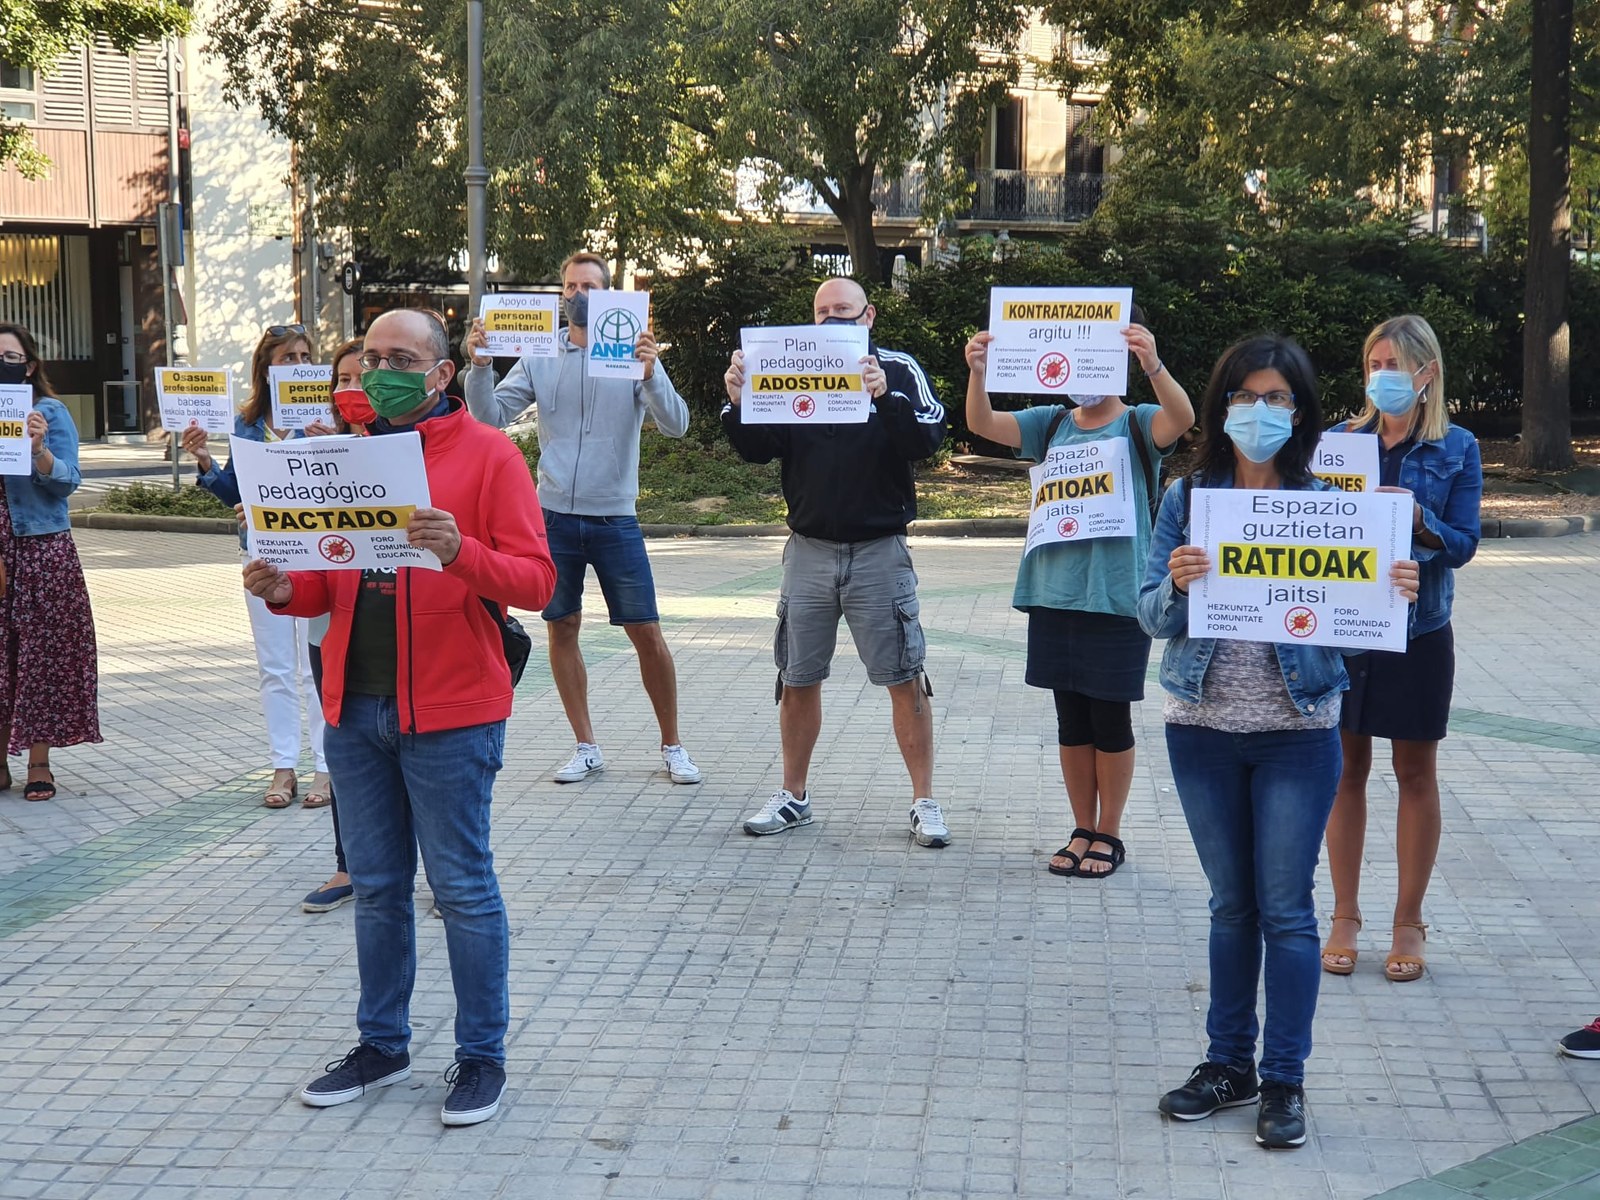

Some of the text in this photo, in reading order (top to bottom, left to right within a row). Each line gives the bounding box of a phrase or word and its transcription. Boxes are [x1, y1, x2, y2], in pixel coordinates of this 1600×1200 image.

[498, 296, 542, 308] Apoyo de
[493, 312, 542, 321] personal
[1008, 304, 1113, 319] KONTRATAZIOAK
[494, 322, 544, 331] sanitario
[499, 334, 521, 344] cada
[524, 335, 552, 344] centro
[1028, 324, 1091, 343] argitu !!!
[784, 338, 817, 352] Plan
[760, 355, 844, 372] pedagogiko
[172, 372, 214, 382] Osasun
[292, 367, 326, 379] Apoyo
[163, 383, 225, 393] profesionalen
[758, 376, 850, 391] ADOSTUA
[177, 397, 212, 407] babesa
[186, 408, 228, 417] bakoitzean
[281, 408, 293, 416] en
[296, 406, 322, 416] cada
[265, 446, 350, 456] #vueltaseguraysaludable
[1045, 446, 1099, 464] spazio
[1319, 449, 1345, 467] las
[286, 458, 339, 477] Plan
[257, 480, 386, 504] pedagógico
[1045, 502, 1084, 521] jaitsi
[1252, 495, 1358, 519] Espazio
[262, 509, 398, 530] PACTADO
[1088, 518, 1126, 526] COMUNIDAD
[1242, 519, 1364, 541] guztietan
[376, 551, 422, 559] EDUCATIVA
[1222, 545, 1371, 580] RATIOAK
[1265, 583, 1326, 606] jaitsi
[1207, 603, 1260, 613] HEZKUNTZA
[1333, 607, 1360, 616] FORO
[1207, 613, 1264, 624] KOMUNITATE
[1333, 618, 1391, 628] COMUNIDAD
[1207, 623, 1239, 632] FOROA
[1333, 628, 1384, 638] EDUCATIVA
